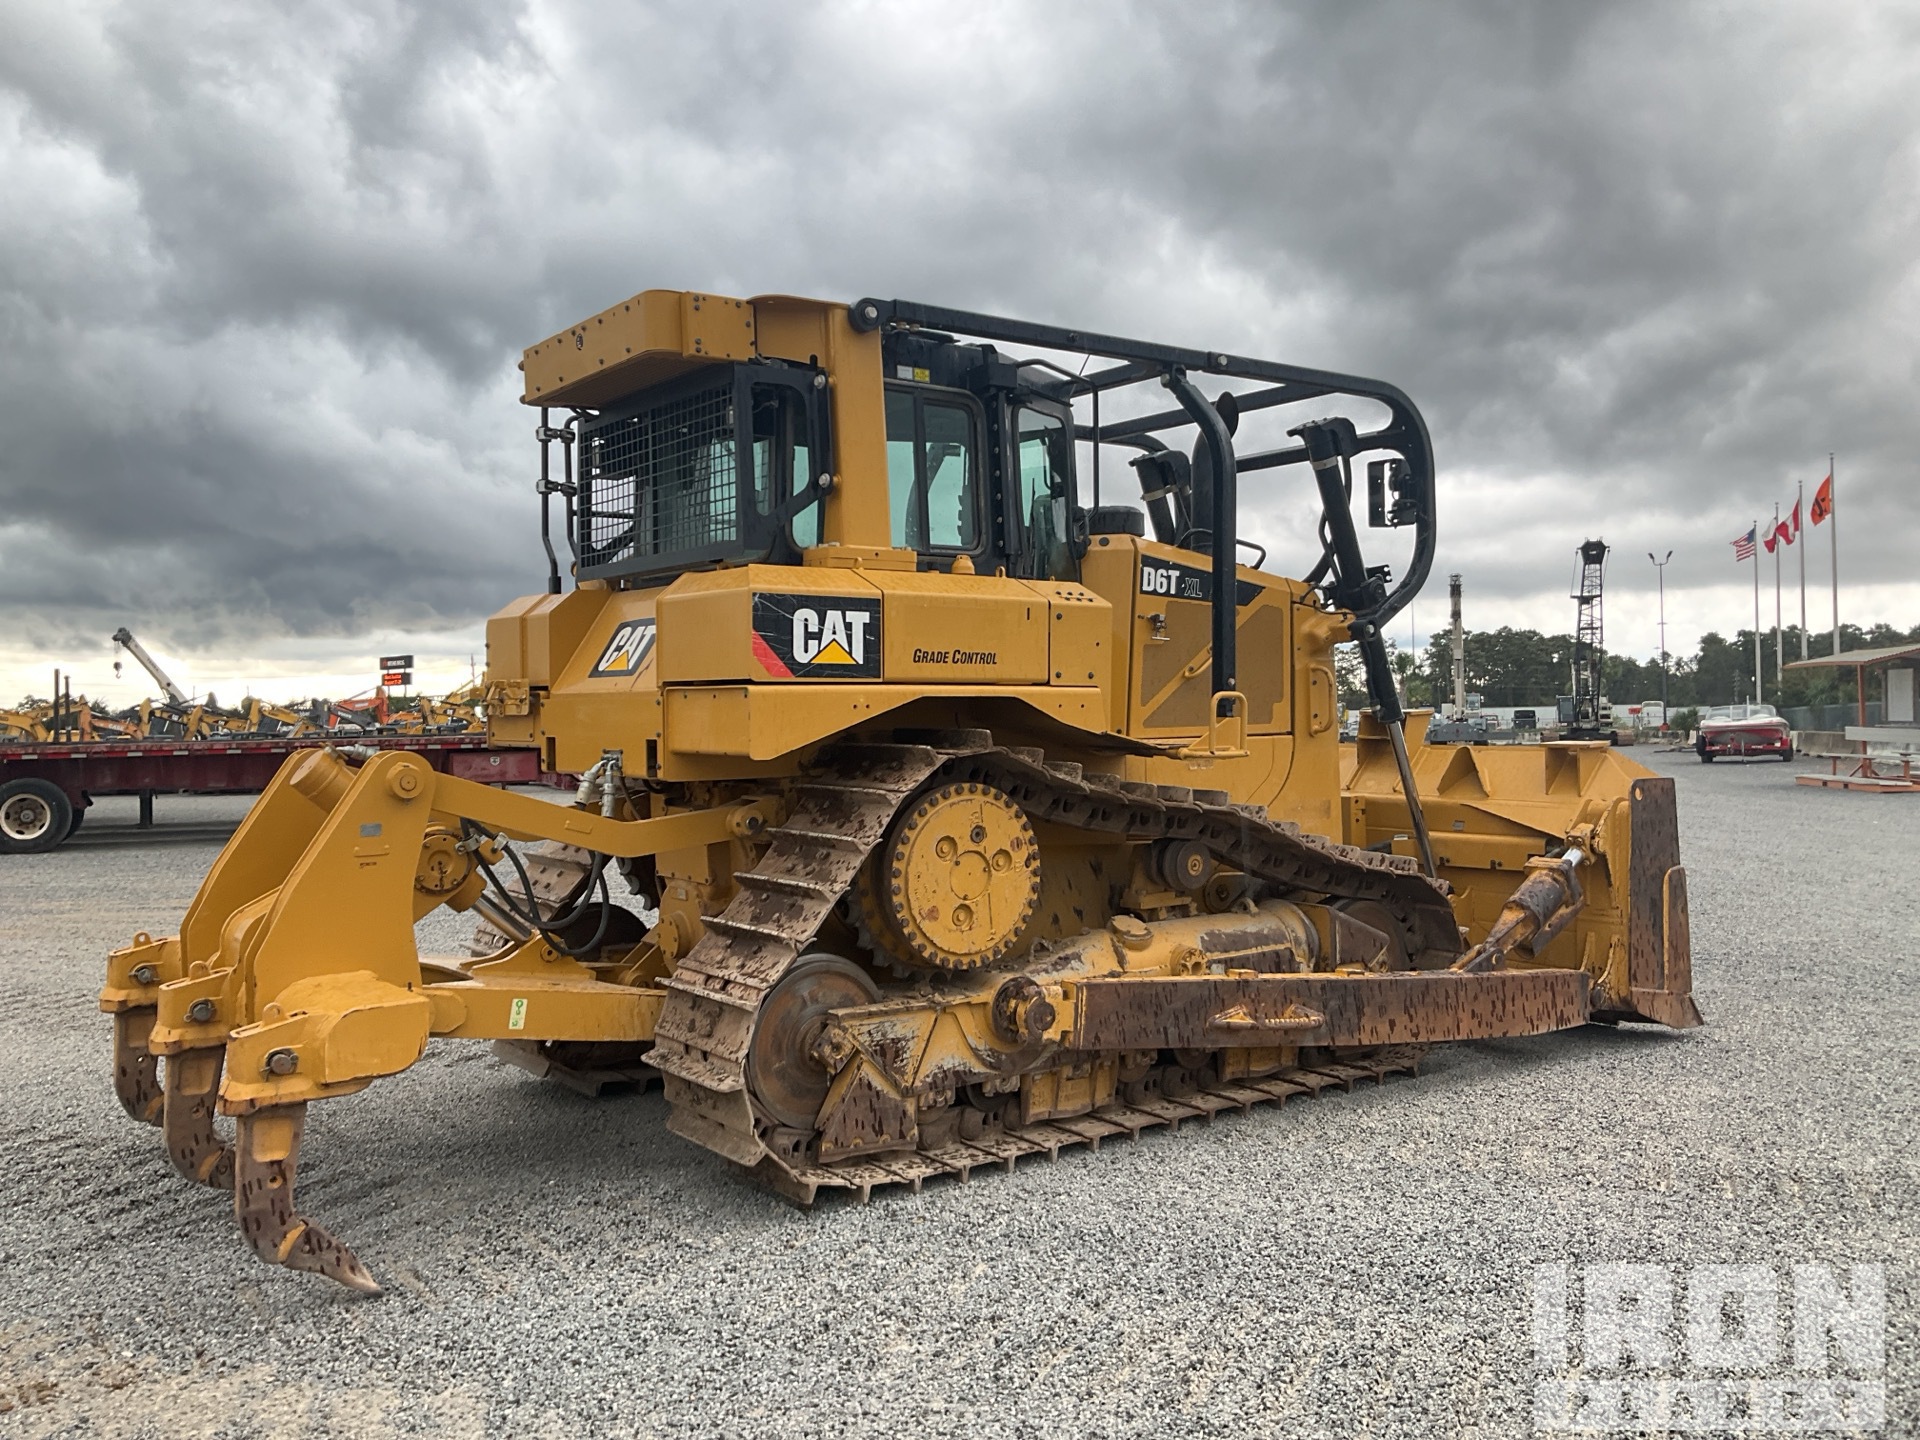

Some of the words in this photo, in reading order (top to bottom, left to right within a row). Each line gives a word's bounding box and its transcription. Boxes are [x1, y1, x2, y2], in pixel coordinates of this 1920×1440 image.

[1142, 567, 1180, 595] D6T
[1184, 577, 1202, 598] XL
[598, 625, 656, 671] CAT
[793, 608, 870, 665] CAT
